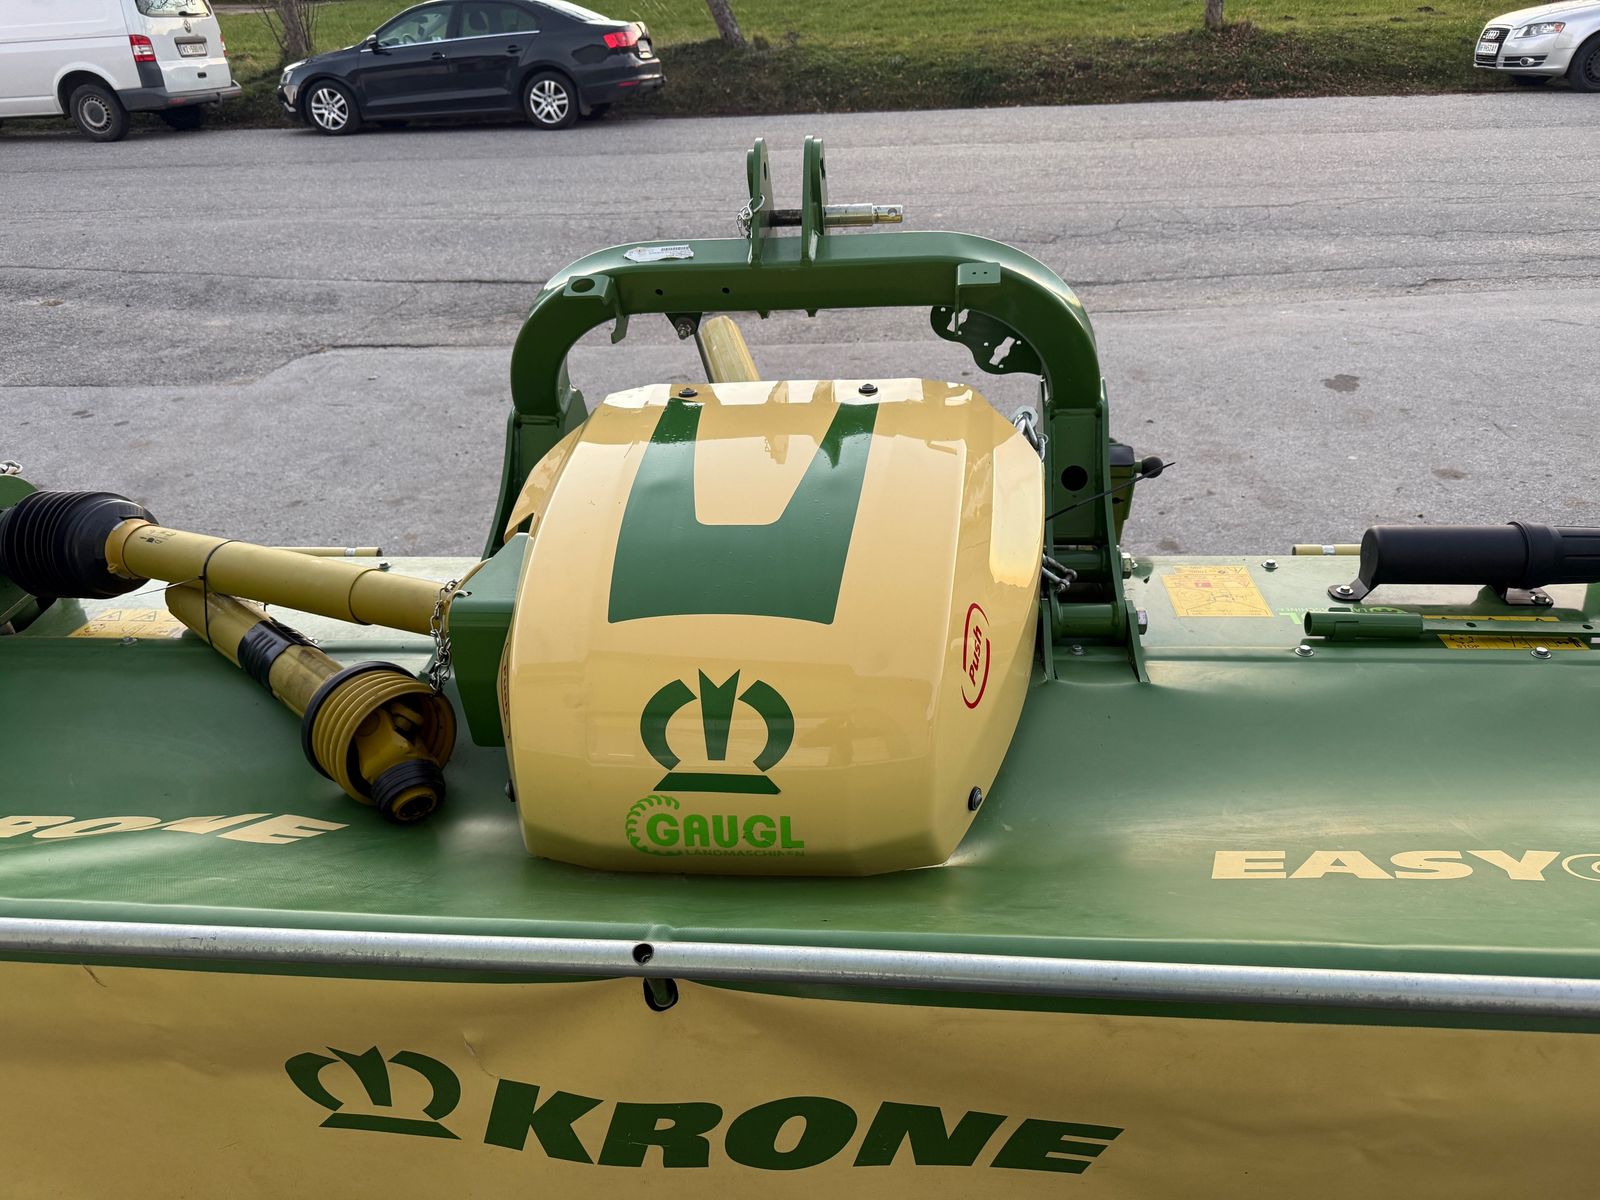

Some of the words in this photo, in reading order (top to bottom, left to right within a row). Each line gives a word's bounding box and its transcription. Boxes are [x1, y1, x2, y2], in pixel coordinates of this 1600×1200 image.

[969, 625, 982, 688] push
[0, 813, 350, 844] RONE
[646, 813, 805, 849] GAUGL
[483, 1079, 1125, 1174] KRONE
